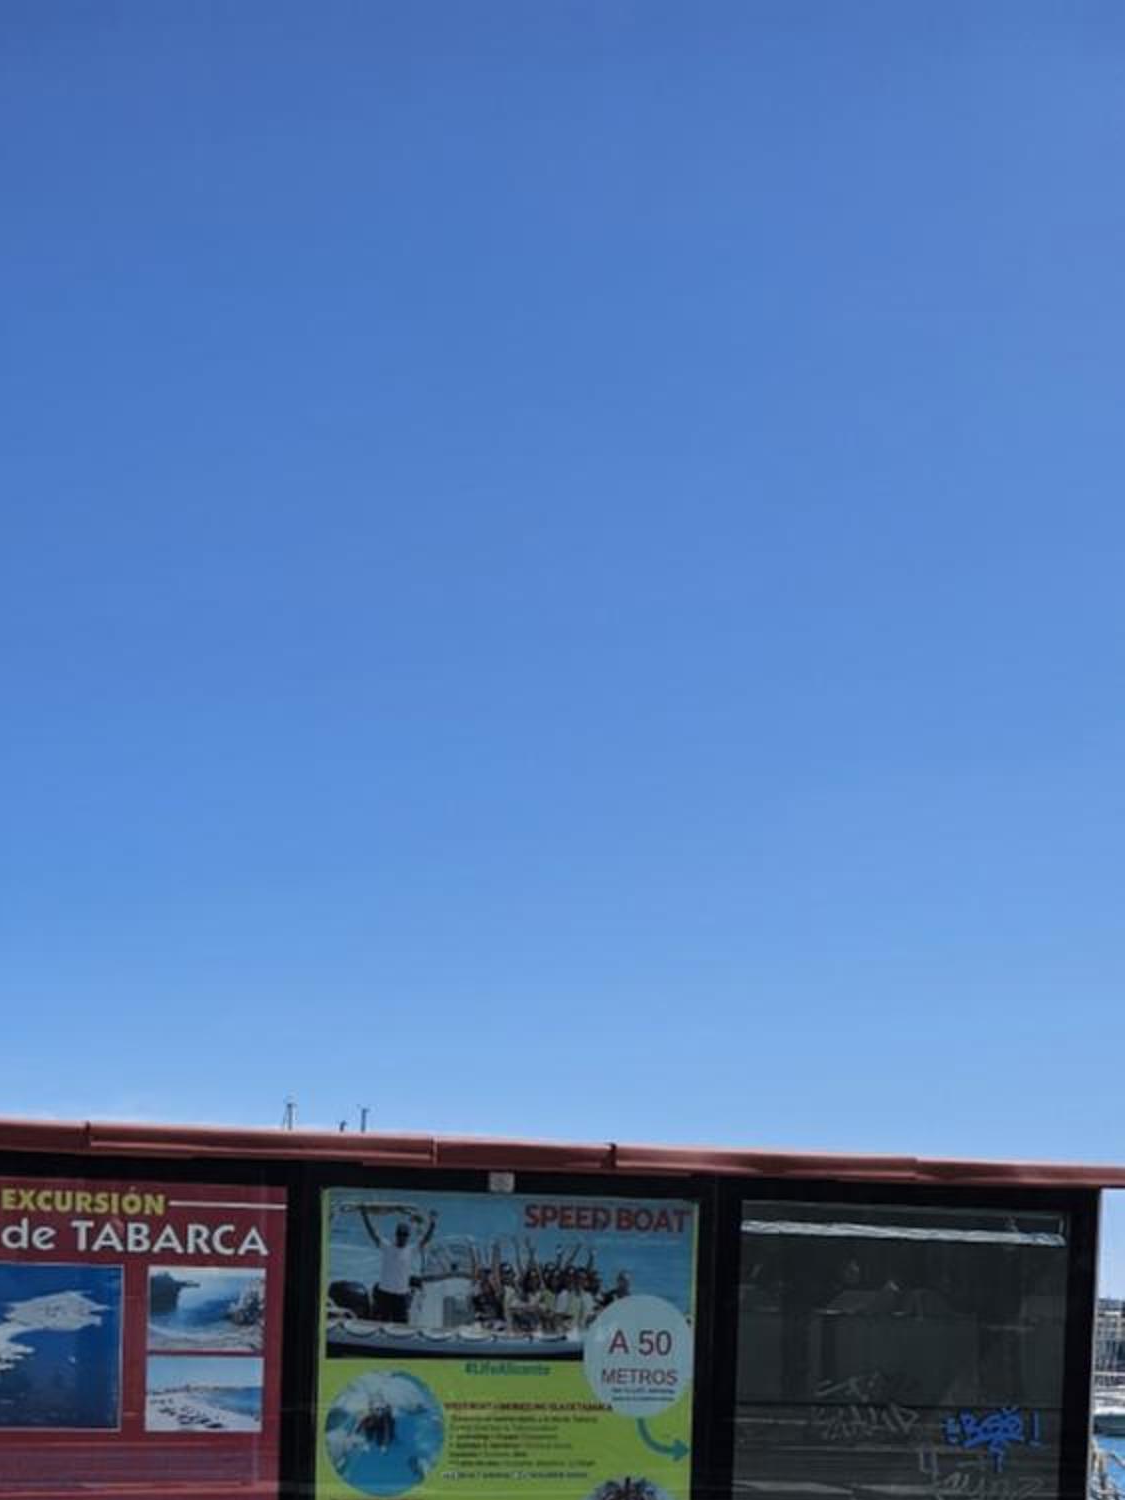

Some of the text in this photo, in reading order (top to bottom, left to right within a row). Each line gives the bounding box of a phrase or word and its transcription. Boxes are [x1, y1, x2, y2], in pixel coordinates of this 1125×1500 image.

[1, 1186, 166, 1216] EXCURSIÓN
[524, 1203, 692, 1234] SPEED BOAT
[1, 1217, 56, 1250] de
[71, 1220, 269, 1256] TABARCA
[608, 1329, 672, 1356] A 50
[601, 1367, 678, 1386] METROS
